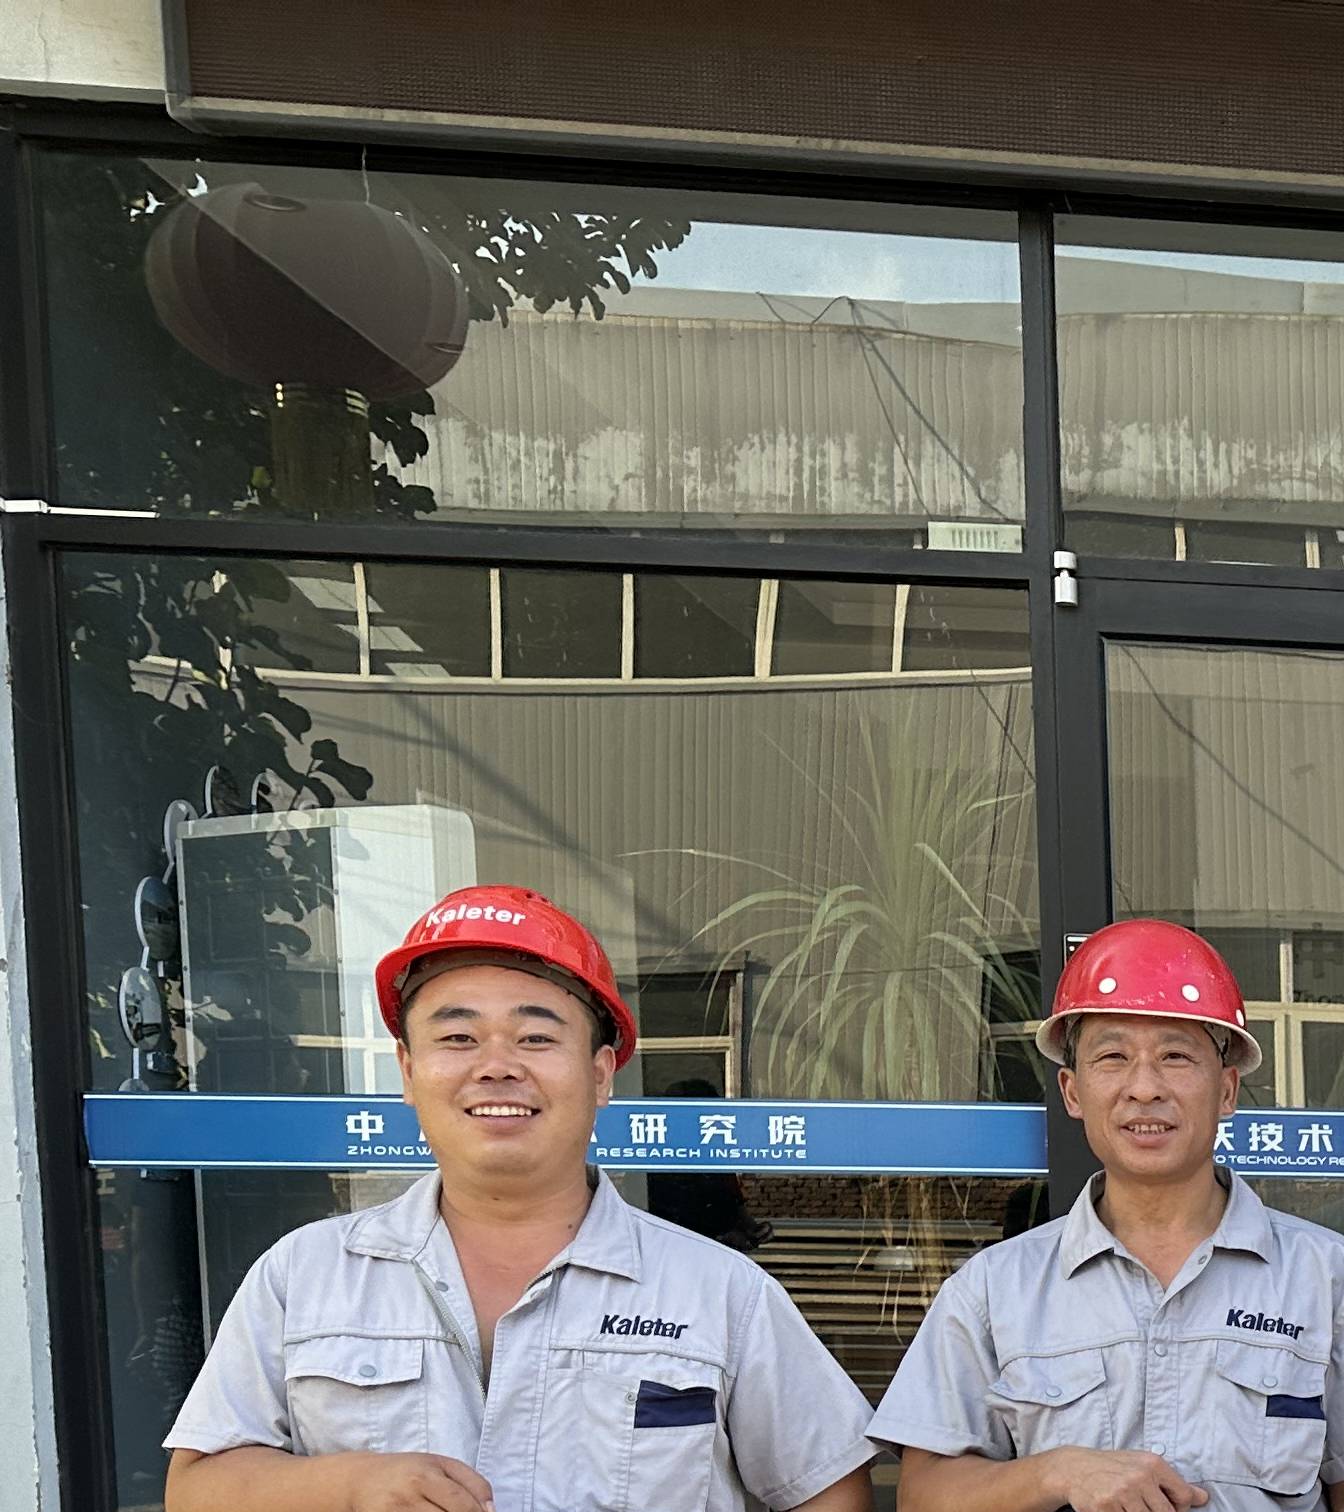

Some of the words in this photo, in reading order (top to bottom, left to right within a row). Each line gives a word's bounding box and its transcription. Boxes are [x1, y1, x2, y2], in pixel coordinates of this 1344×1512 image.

[425, 902, 526, 927] Kaleter
[590, 1112, 807, 1147] 研究院
[347, 1145, 432, 1156] ZHONGW
[597, 1147, 701, 1159] RESEARCH
[710, 1148, 807, 1160] INSTITUTE
[1229, 1154, 1325, 1166] TECHNOLOGY
[600, 1314, 688, 1339] Kaleter
[1226, 1309, 1304, 1340] Kaleter
